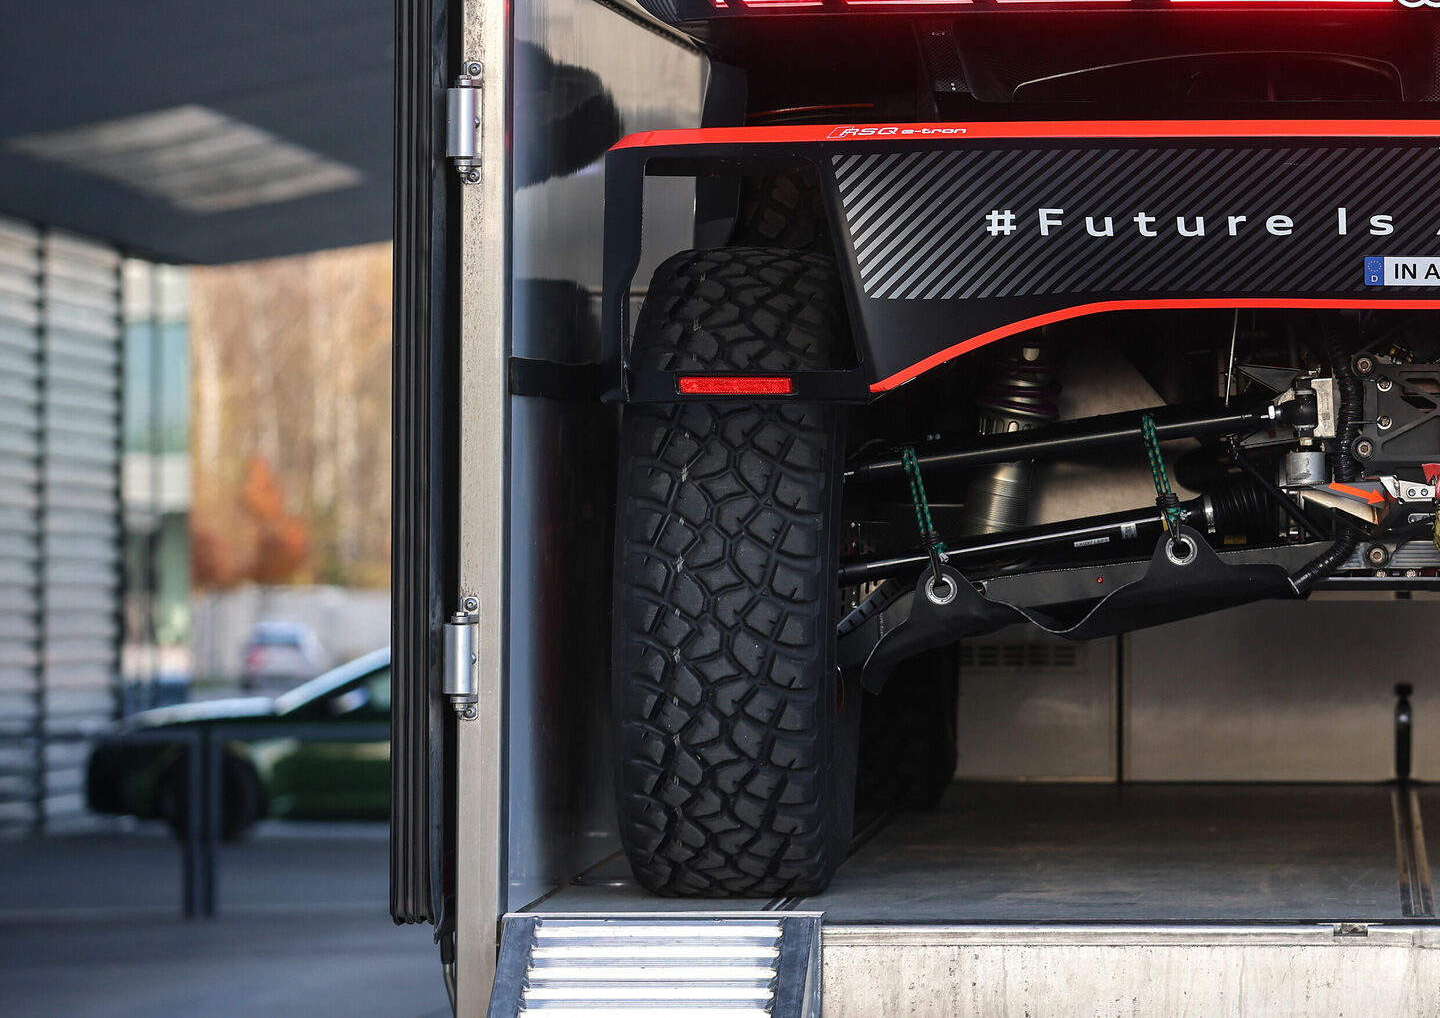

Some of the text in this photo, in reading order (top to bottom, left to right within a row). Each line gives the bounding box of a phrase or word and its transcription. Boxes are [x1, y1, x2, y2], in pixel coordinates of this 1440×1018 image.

[985, 208, 1294, 237] #Future
[1337, 207, 1394, 236] Is
[1370, 275, 1379, 283] D
[1394, 263, 1417, 280] IN
